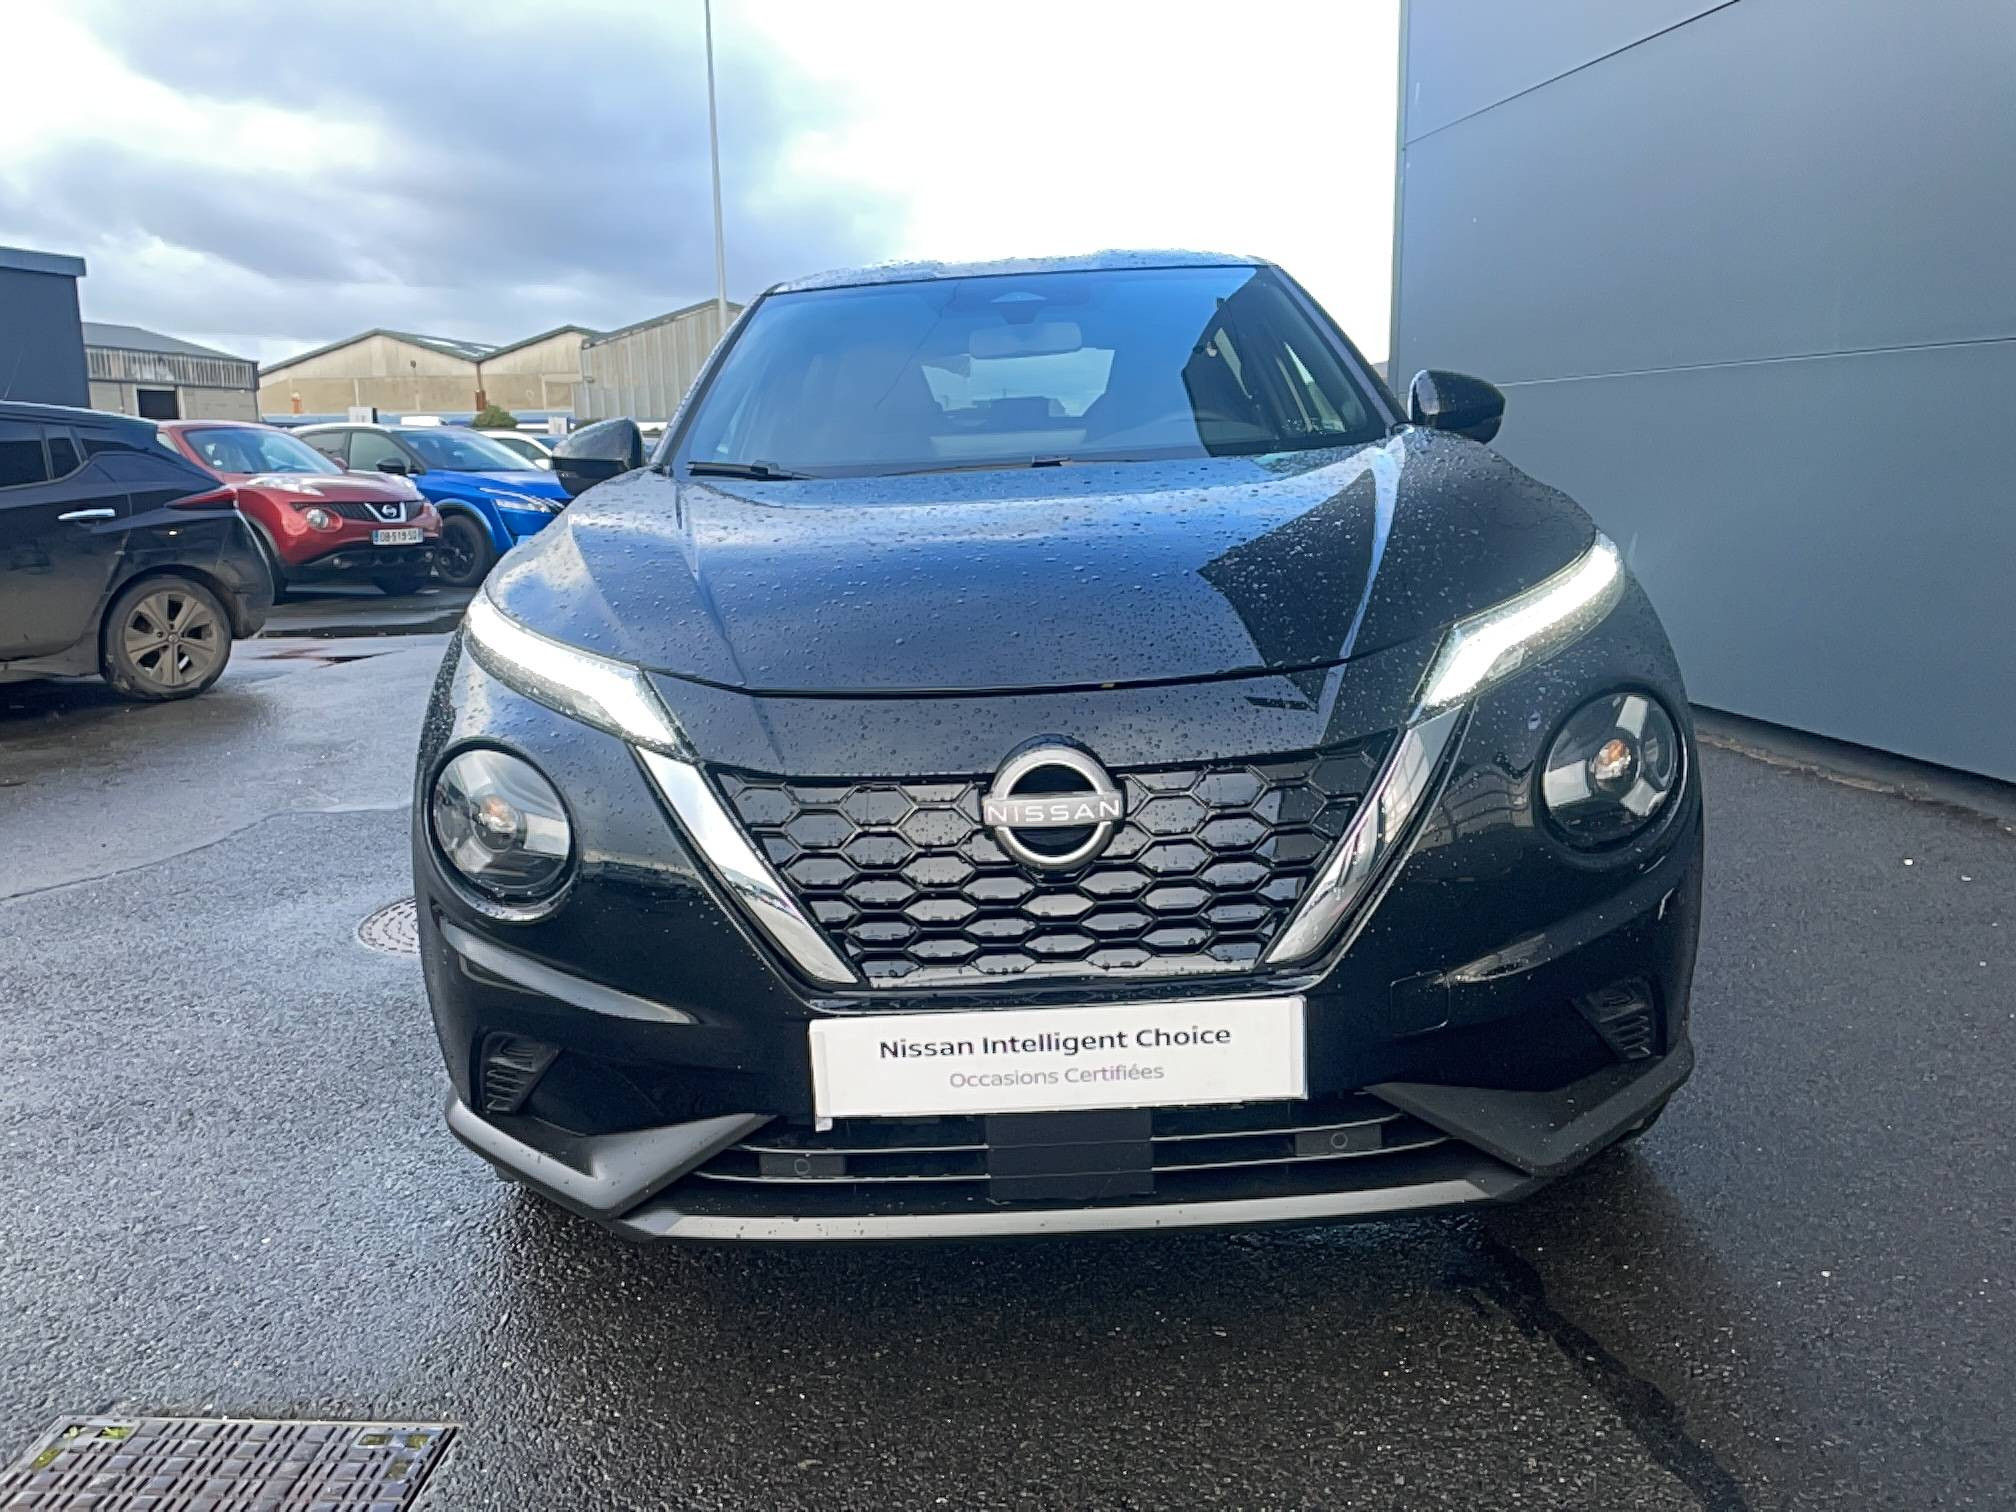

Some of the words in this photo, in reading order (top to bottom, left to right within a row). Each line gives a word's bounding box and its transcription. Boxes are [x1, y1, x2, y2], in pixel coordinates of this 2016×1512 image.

[987, 799, 1121, 823] NISSAN
[879, 1038, 975, 1060] Nissan
[982, 1029, 1129, 1057] Intelligent
[1135, 1026, 1232, 1049] Choice
[949, 1070, 1059, 1088] Occasions
[1063, 1063, 1165, 1083] Certifiées
